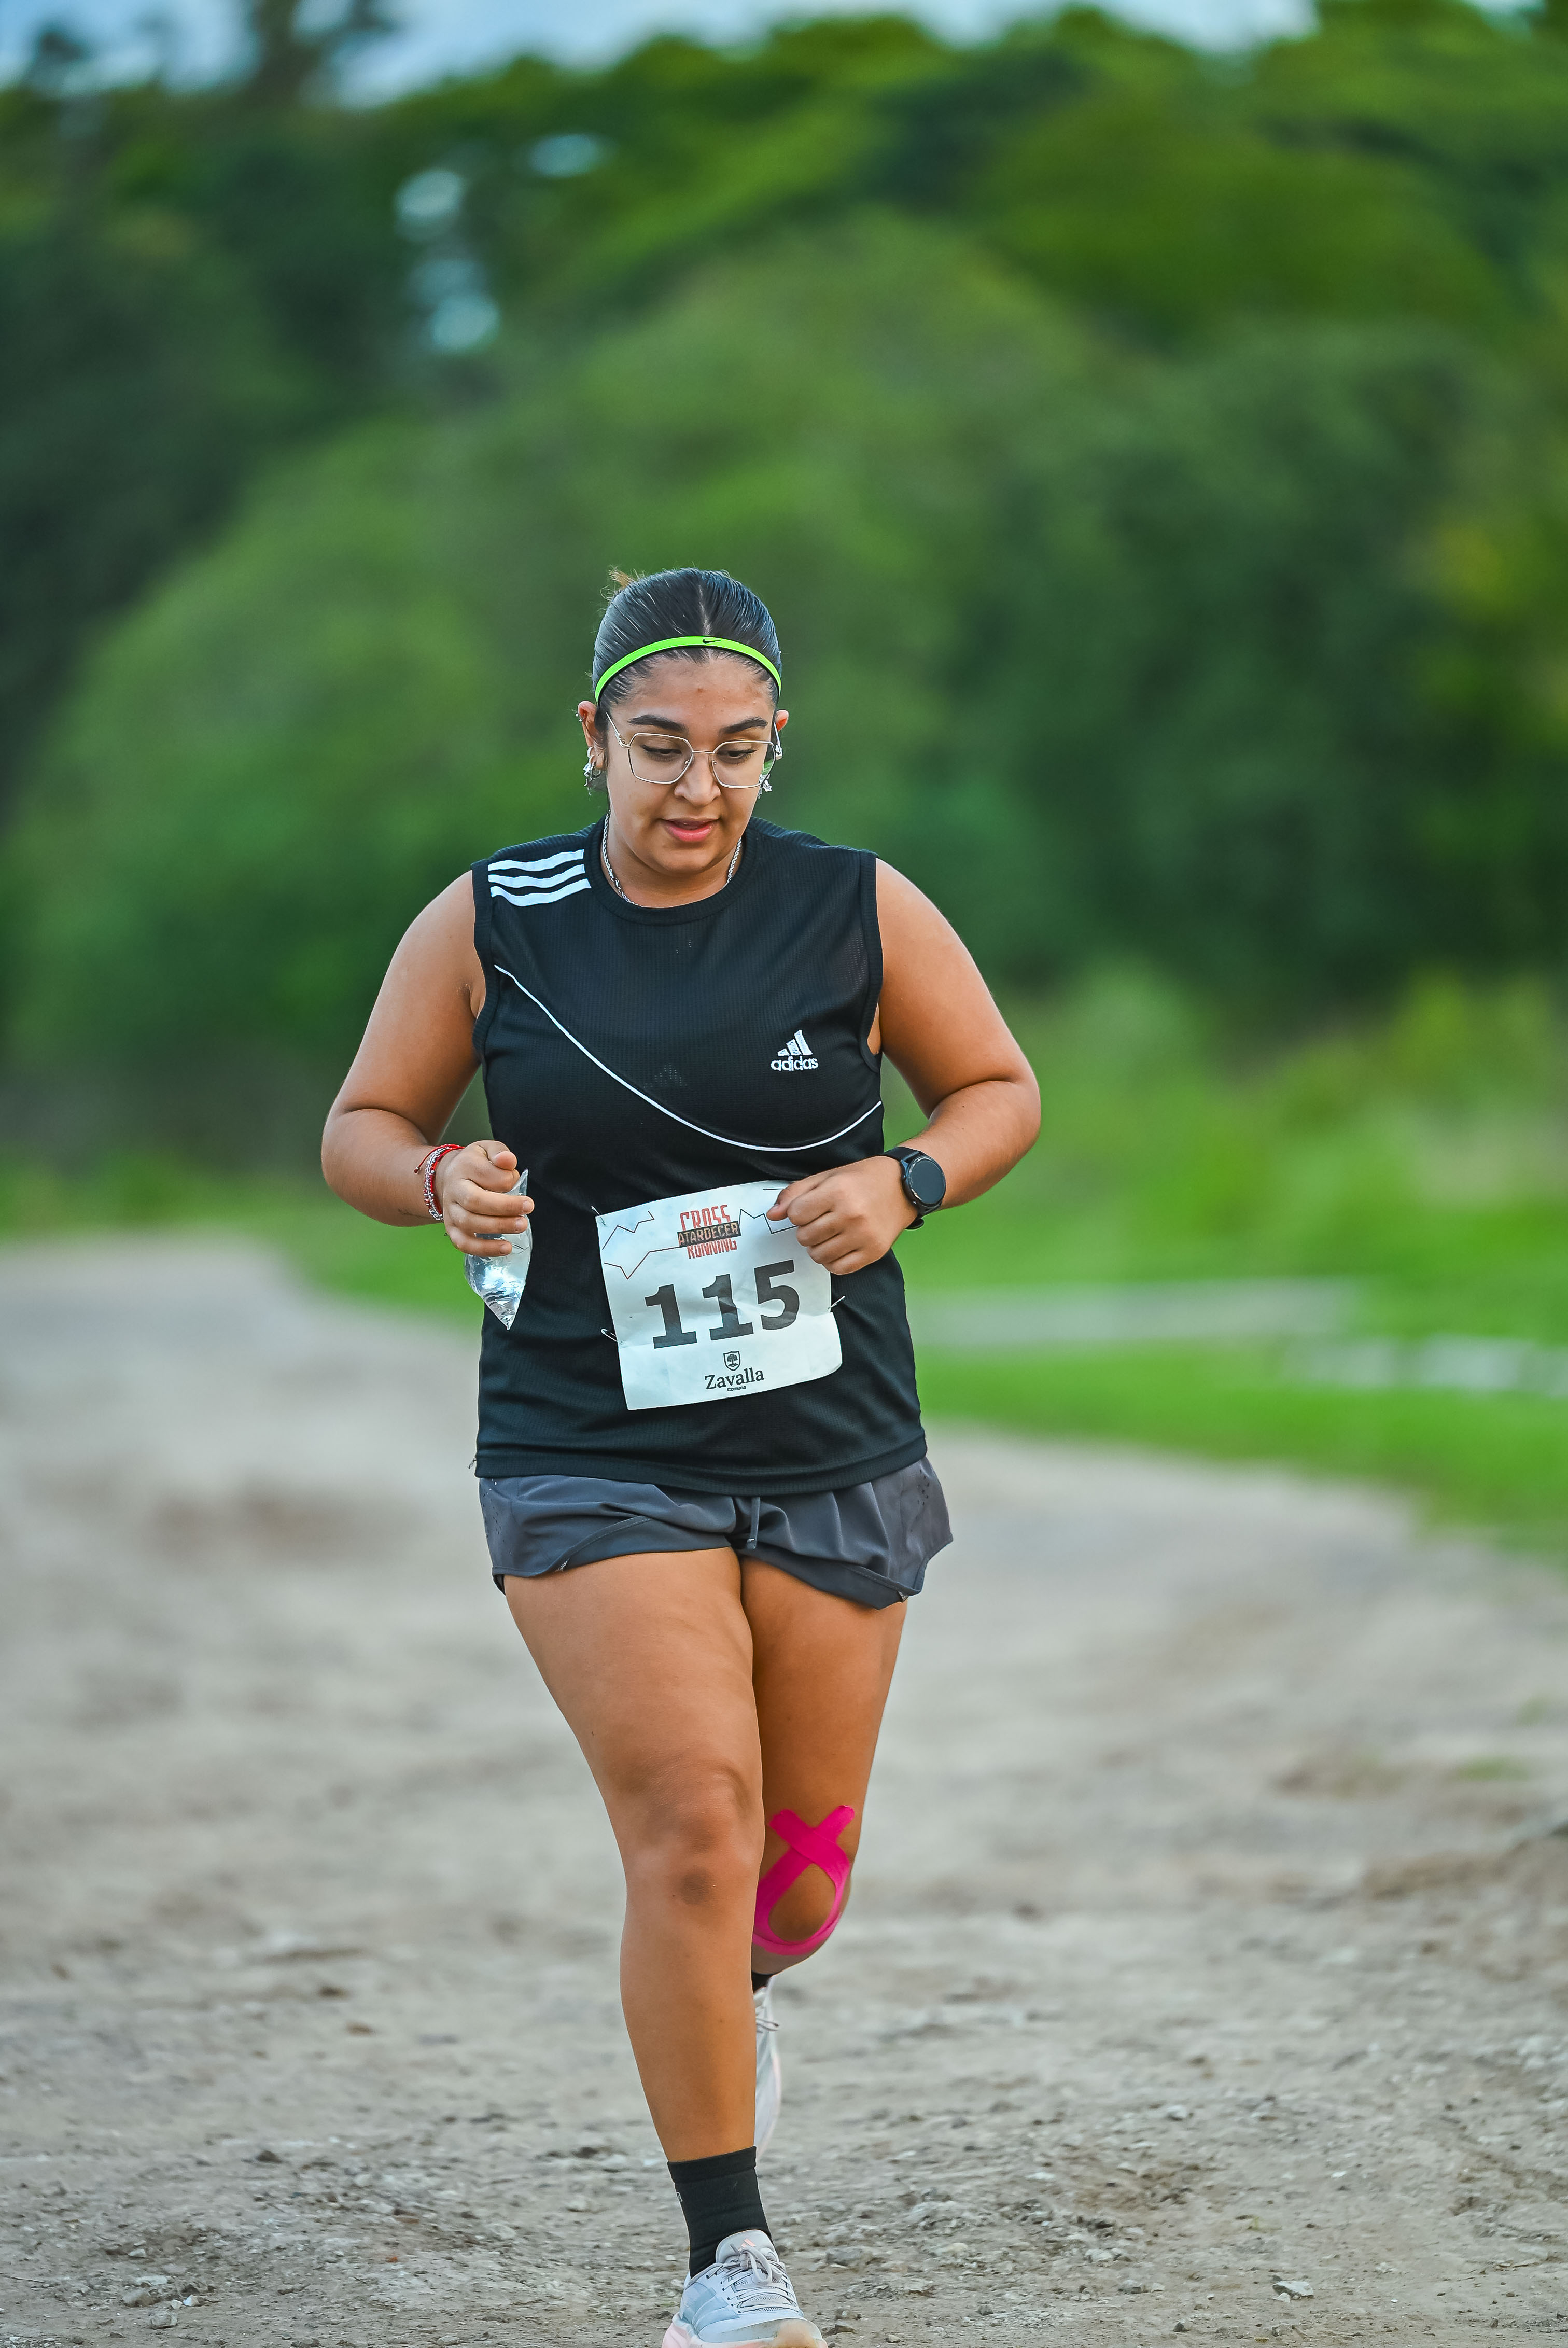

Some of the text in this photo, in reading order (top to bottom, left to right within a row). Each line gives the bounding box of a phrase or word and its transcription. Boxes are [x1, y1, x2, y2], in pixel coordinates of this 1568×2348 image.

[771, 1056, 819, 1071] adidas
[680, 1204, 731, 1232] CROSS
[678, 1222, 739, 1246] ATARDECER
[645, 1259, 800, 1349] 115
[705, 1367, 765, 1390] Zavalla
